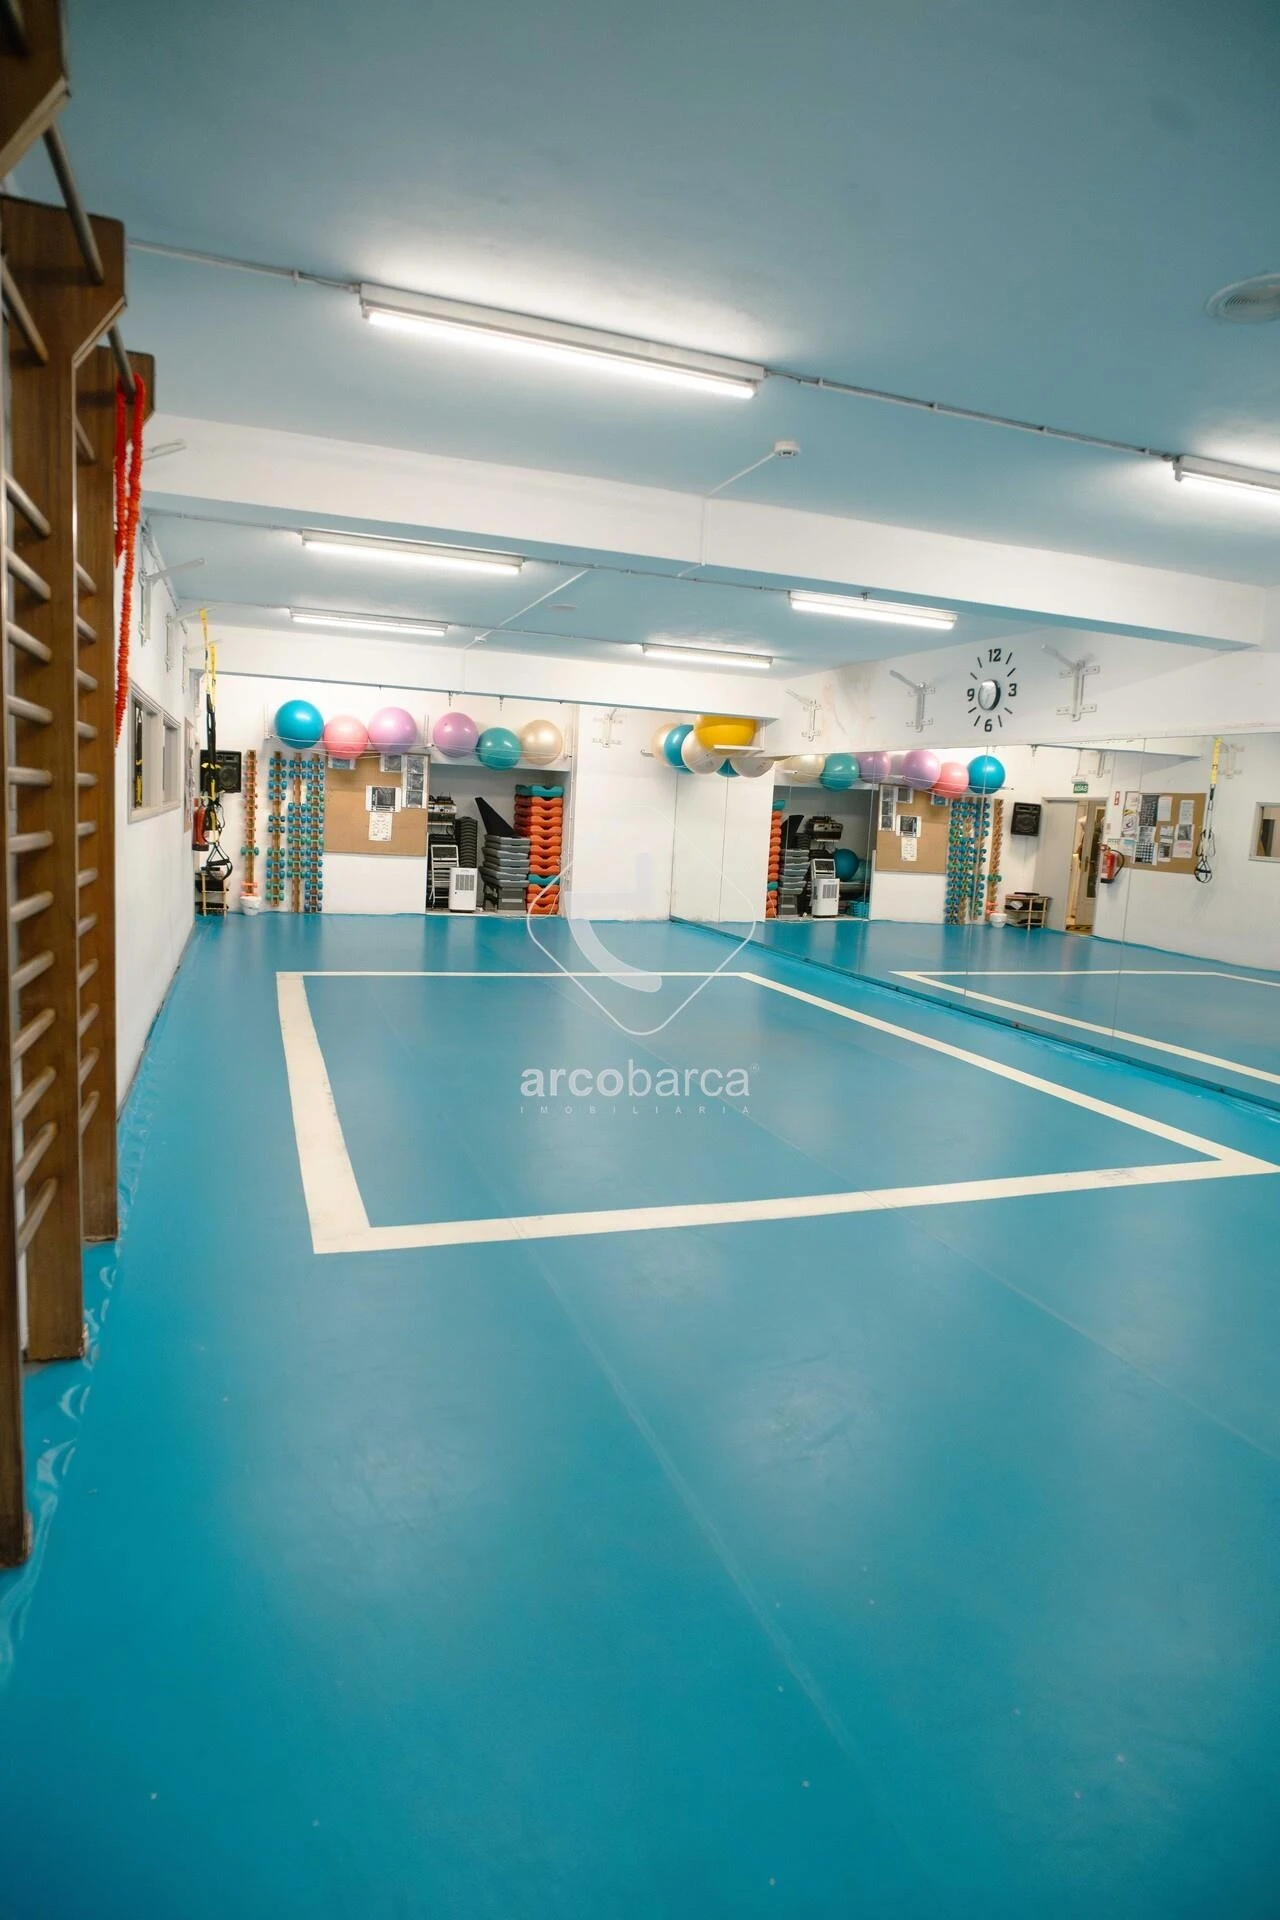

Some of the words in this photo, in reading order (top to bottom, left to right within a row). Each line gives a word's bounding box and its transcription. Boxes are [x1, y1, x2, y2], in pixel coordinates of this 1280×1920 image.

[988, 648, 1002, 662] 12
[967, 688, 975, 702] 9
[1008, 683, 1018, 697] 3
[984, 718, 993, 732] 6
